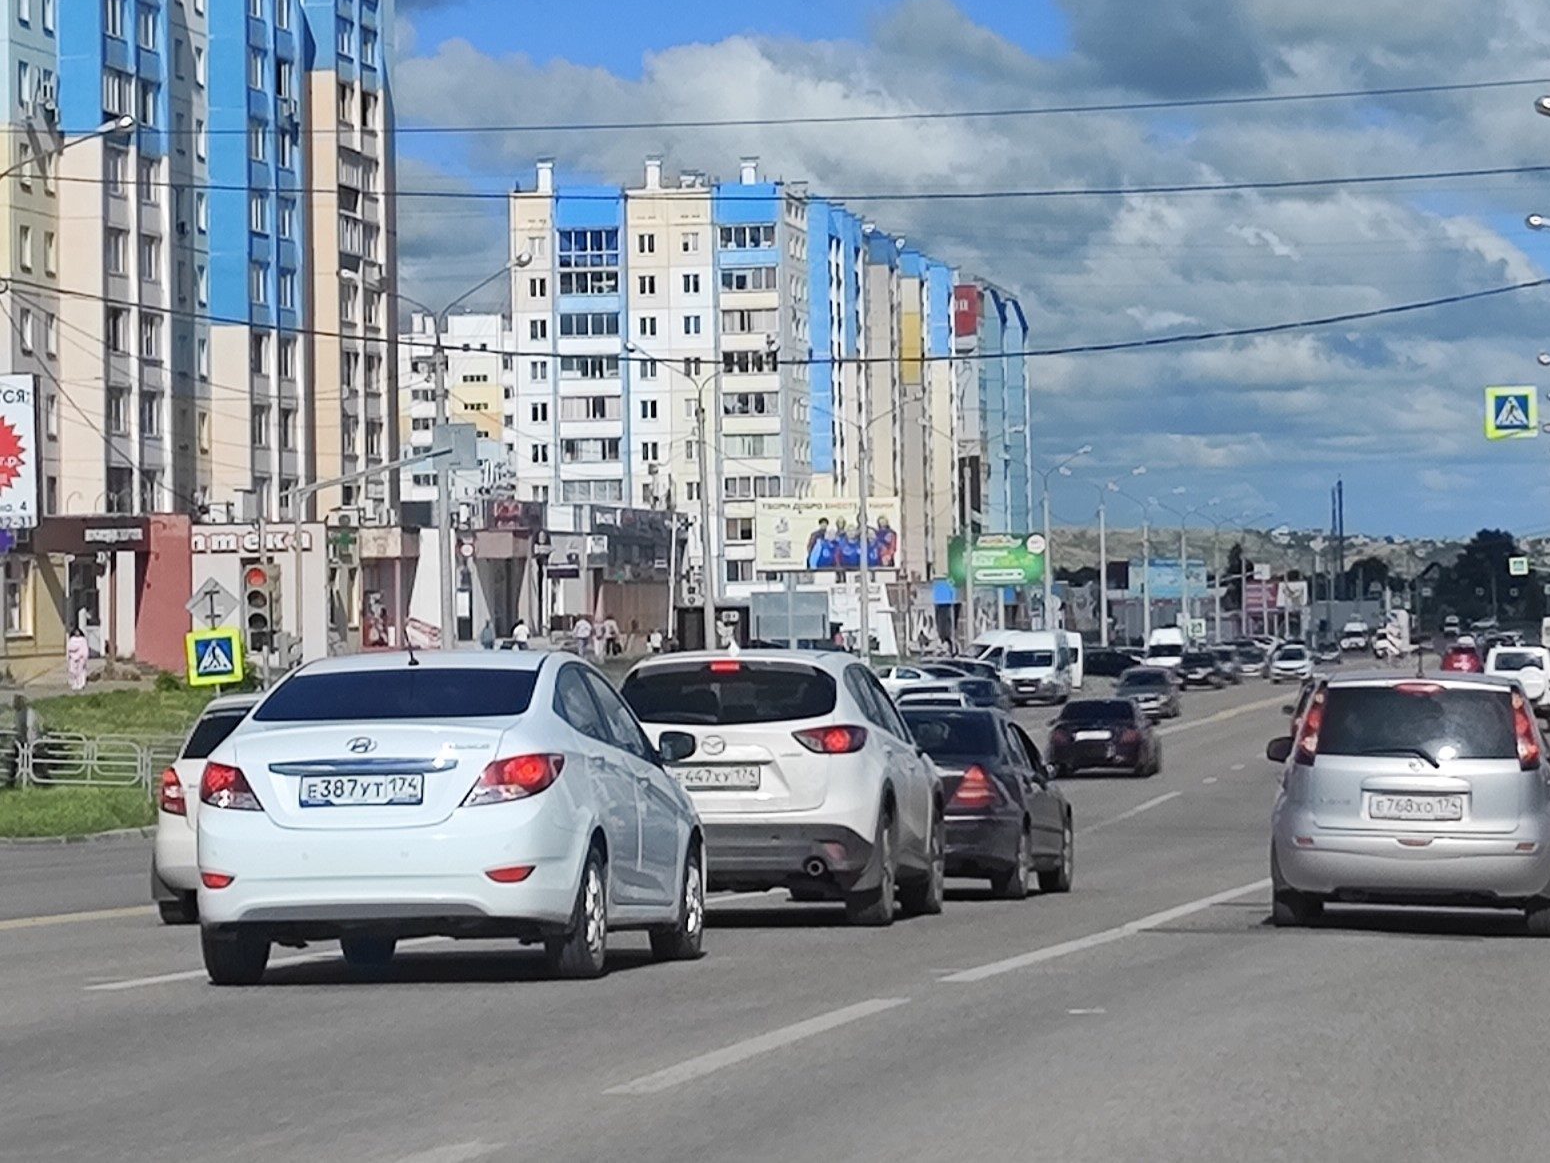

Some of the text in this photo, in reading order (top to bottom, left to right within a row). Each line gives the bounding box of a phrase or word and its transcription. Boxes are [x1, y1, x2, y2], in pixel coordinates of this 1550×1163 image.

[192, 531, 312, 552] птека
[775, 599, 809, 623] СТ
[308, 778, 417, 798] Е387УТ 174
